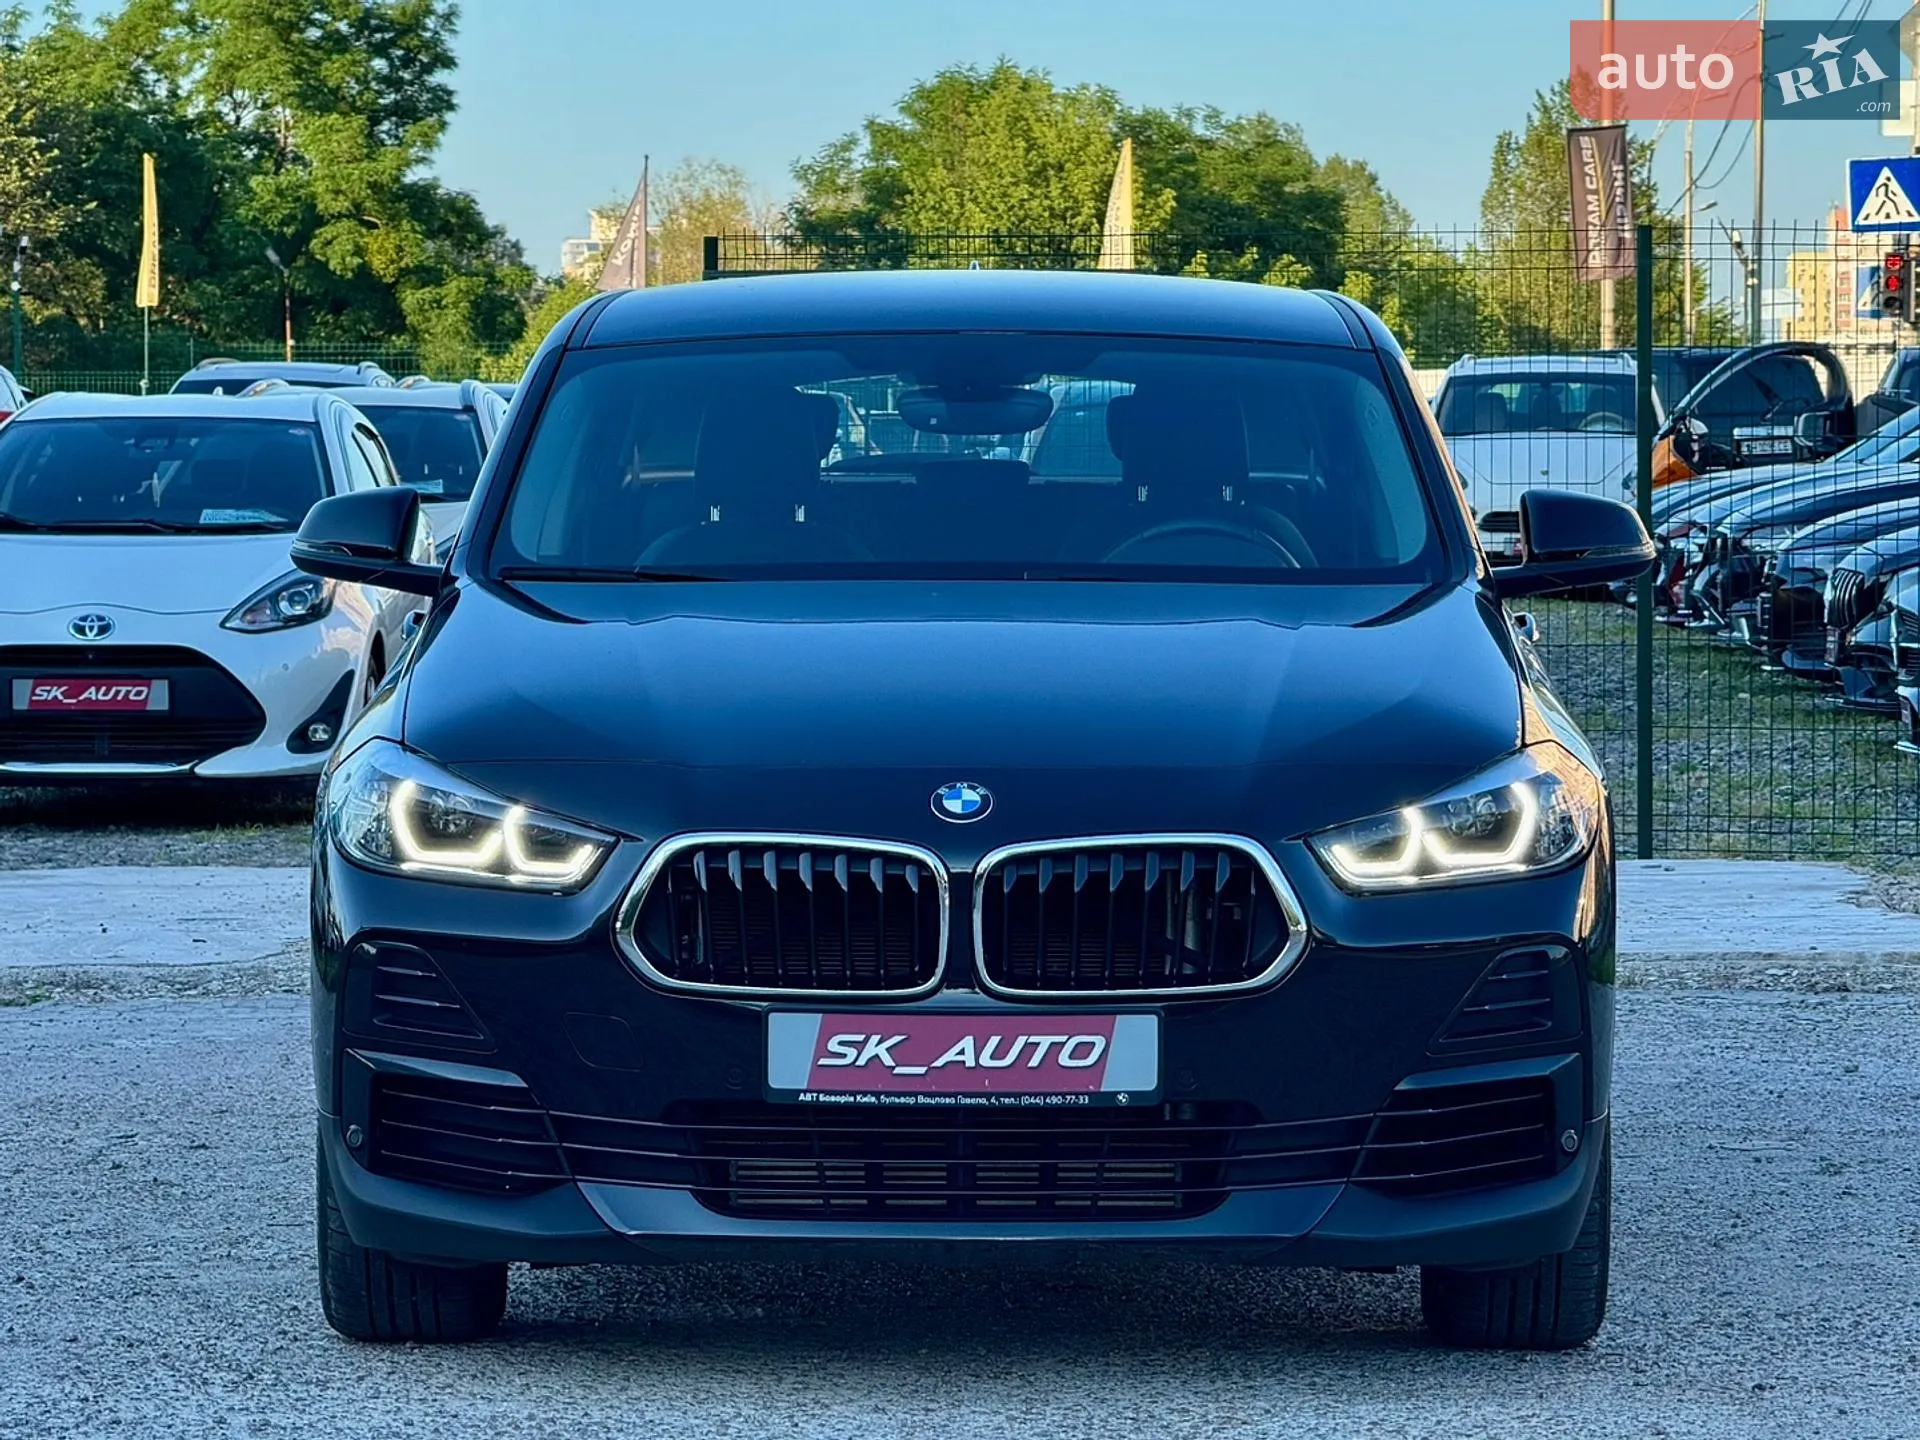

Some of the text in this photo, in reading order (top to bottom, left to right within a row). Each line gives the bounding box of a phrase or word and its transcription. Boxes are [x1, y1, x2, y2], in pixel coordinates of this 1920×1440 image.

[31, 685, 150, 704] SK_AUTO
[816, 1033, 1108, 1076] SK_AUTO
[1021, 1095, 1044, 1106] (044)
[1045, 1094, 1090, 1105] 490-77-33
